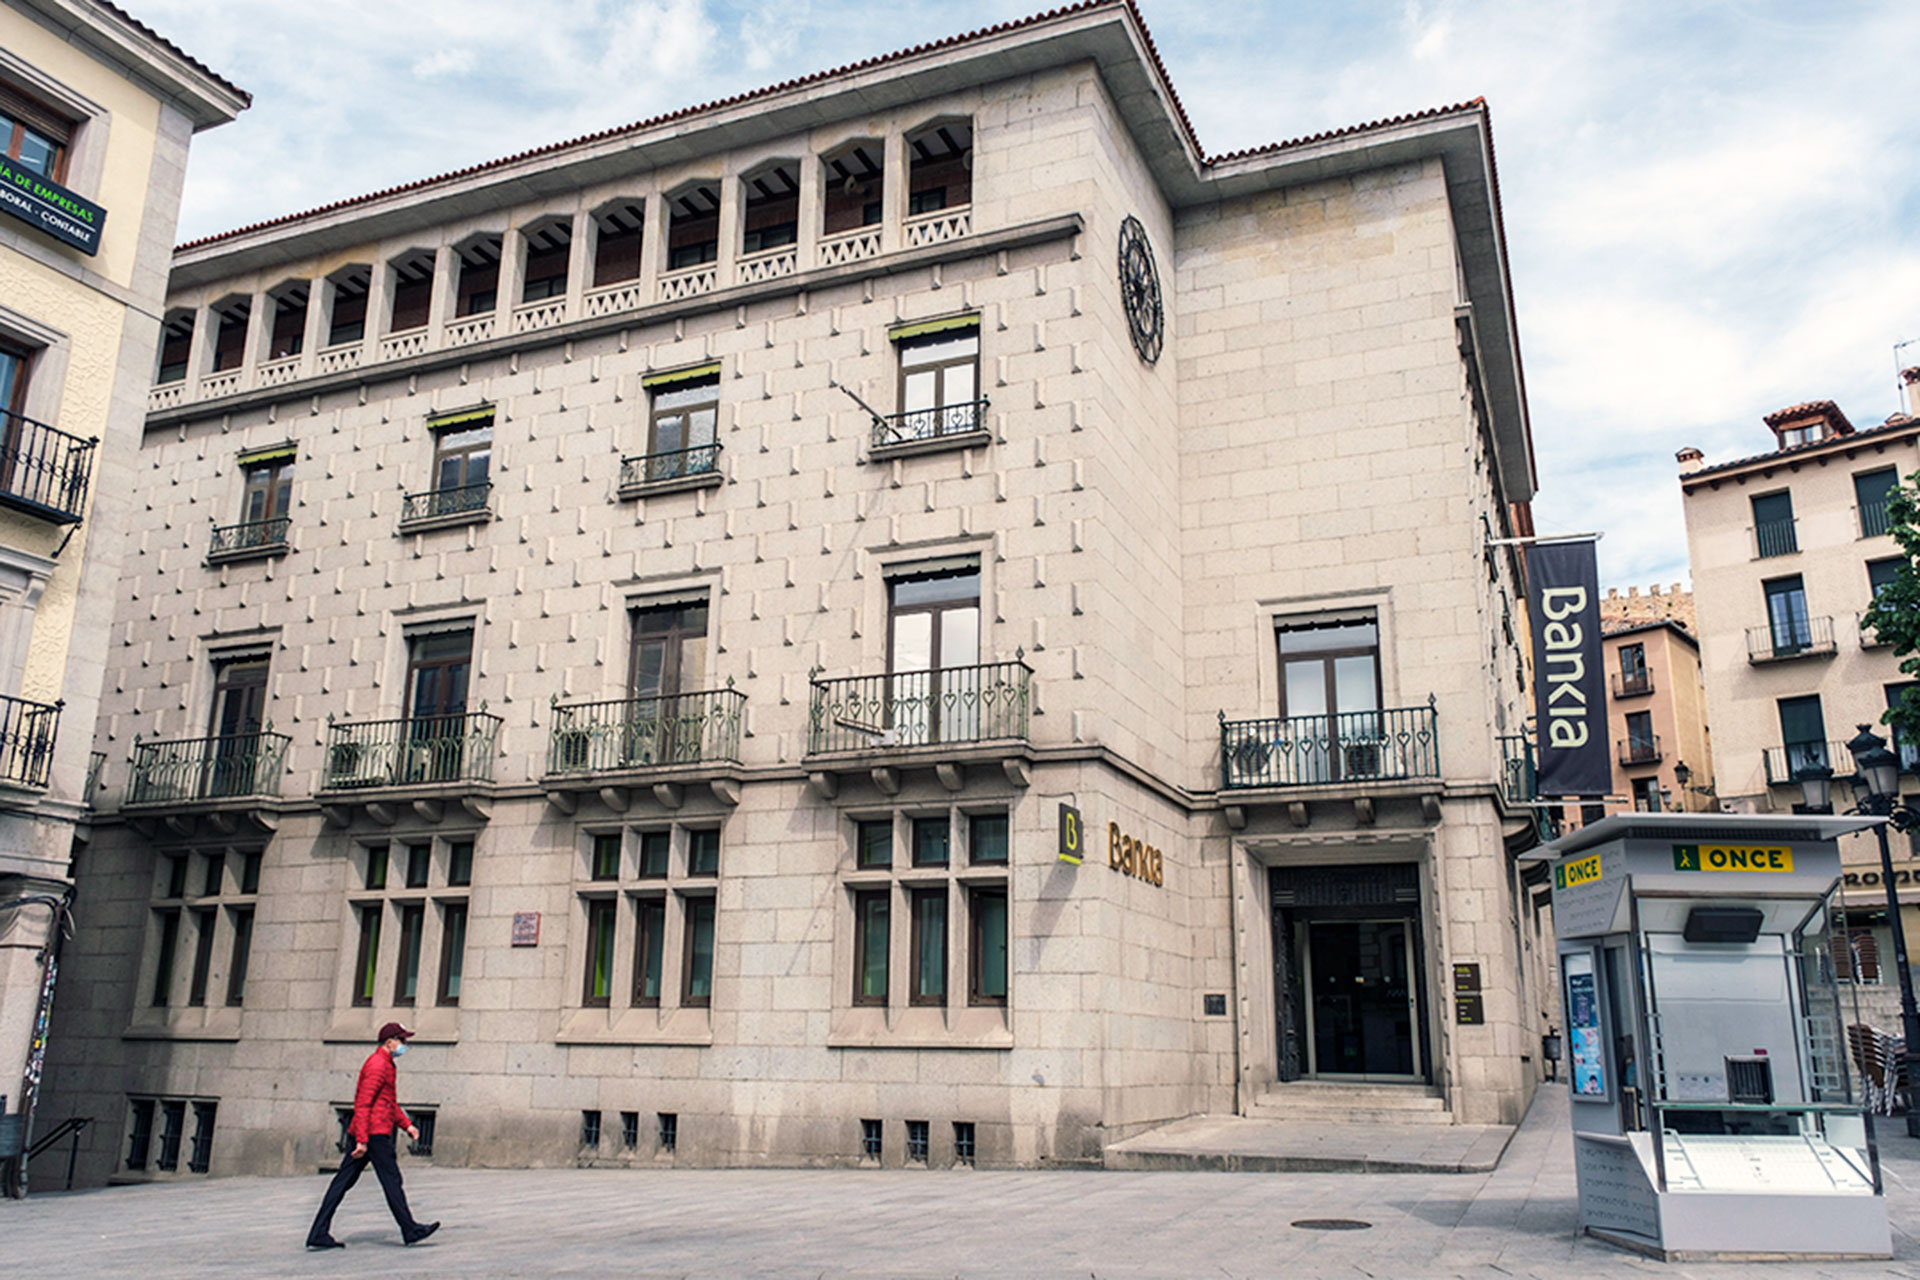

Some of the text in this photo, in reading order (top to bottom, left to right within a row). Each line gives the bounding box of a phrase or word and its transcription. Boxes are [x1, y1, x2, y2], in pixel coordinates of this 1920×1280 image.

[15, 172, 31, 190] DE
[33, 183, 94, 223] EMPRESAS
[40, 211, 91, 242] CONTABLE
[1568, 858, 1598, 883] ONCE
[1708, 849, 1784, 868] ONCE
